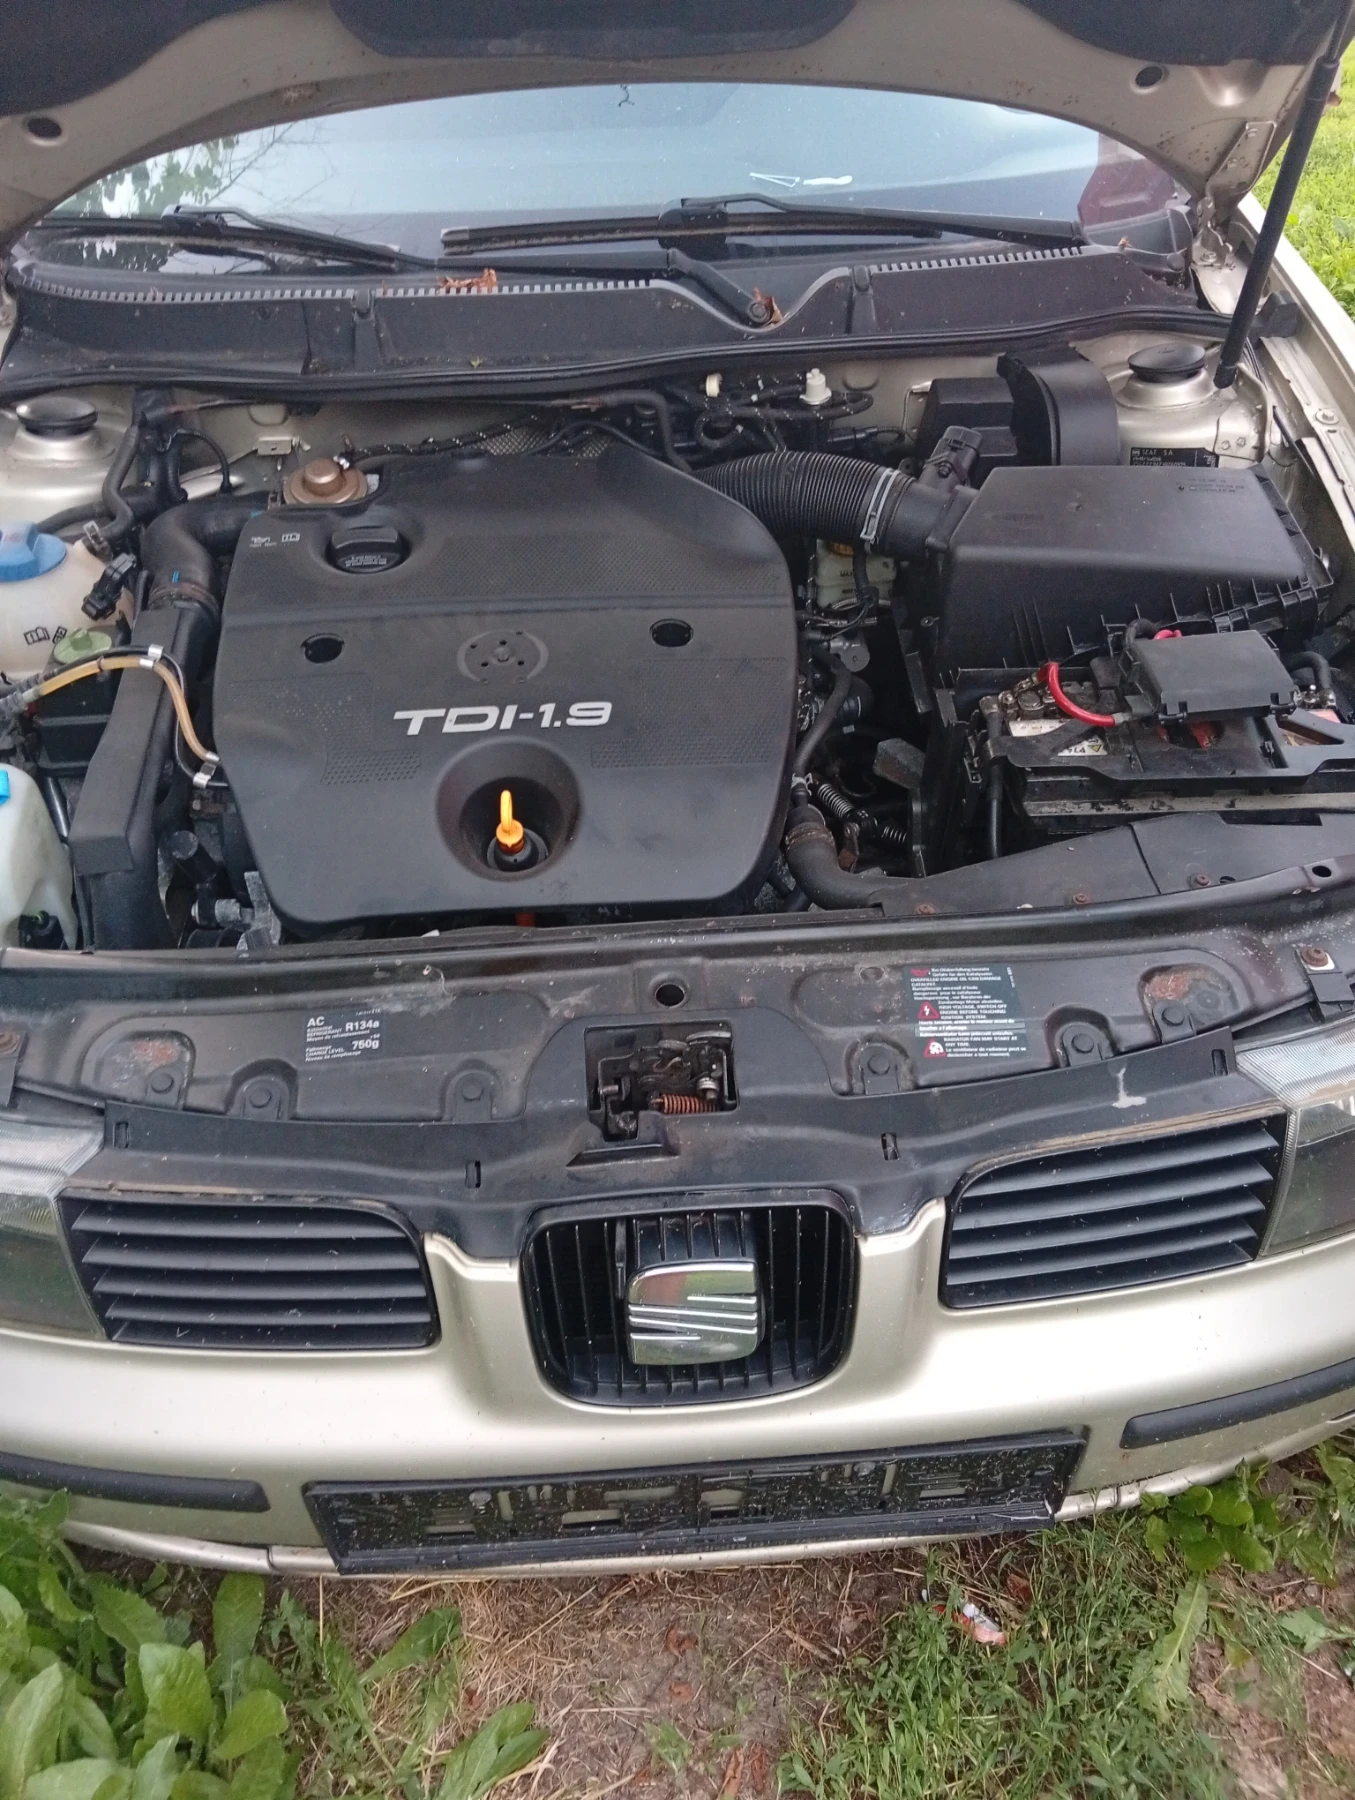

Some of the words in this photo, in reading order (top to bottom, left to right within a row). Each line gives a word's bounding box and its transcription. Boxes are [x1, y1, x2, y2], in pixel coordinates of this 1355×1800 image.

[393, 701, 612, 736] TDI-1.9
[307, 1016, 325, 1028] AC
[345, 1020, 380, 1032] R134a
[352, 1040, 380, 1050] 750g
